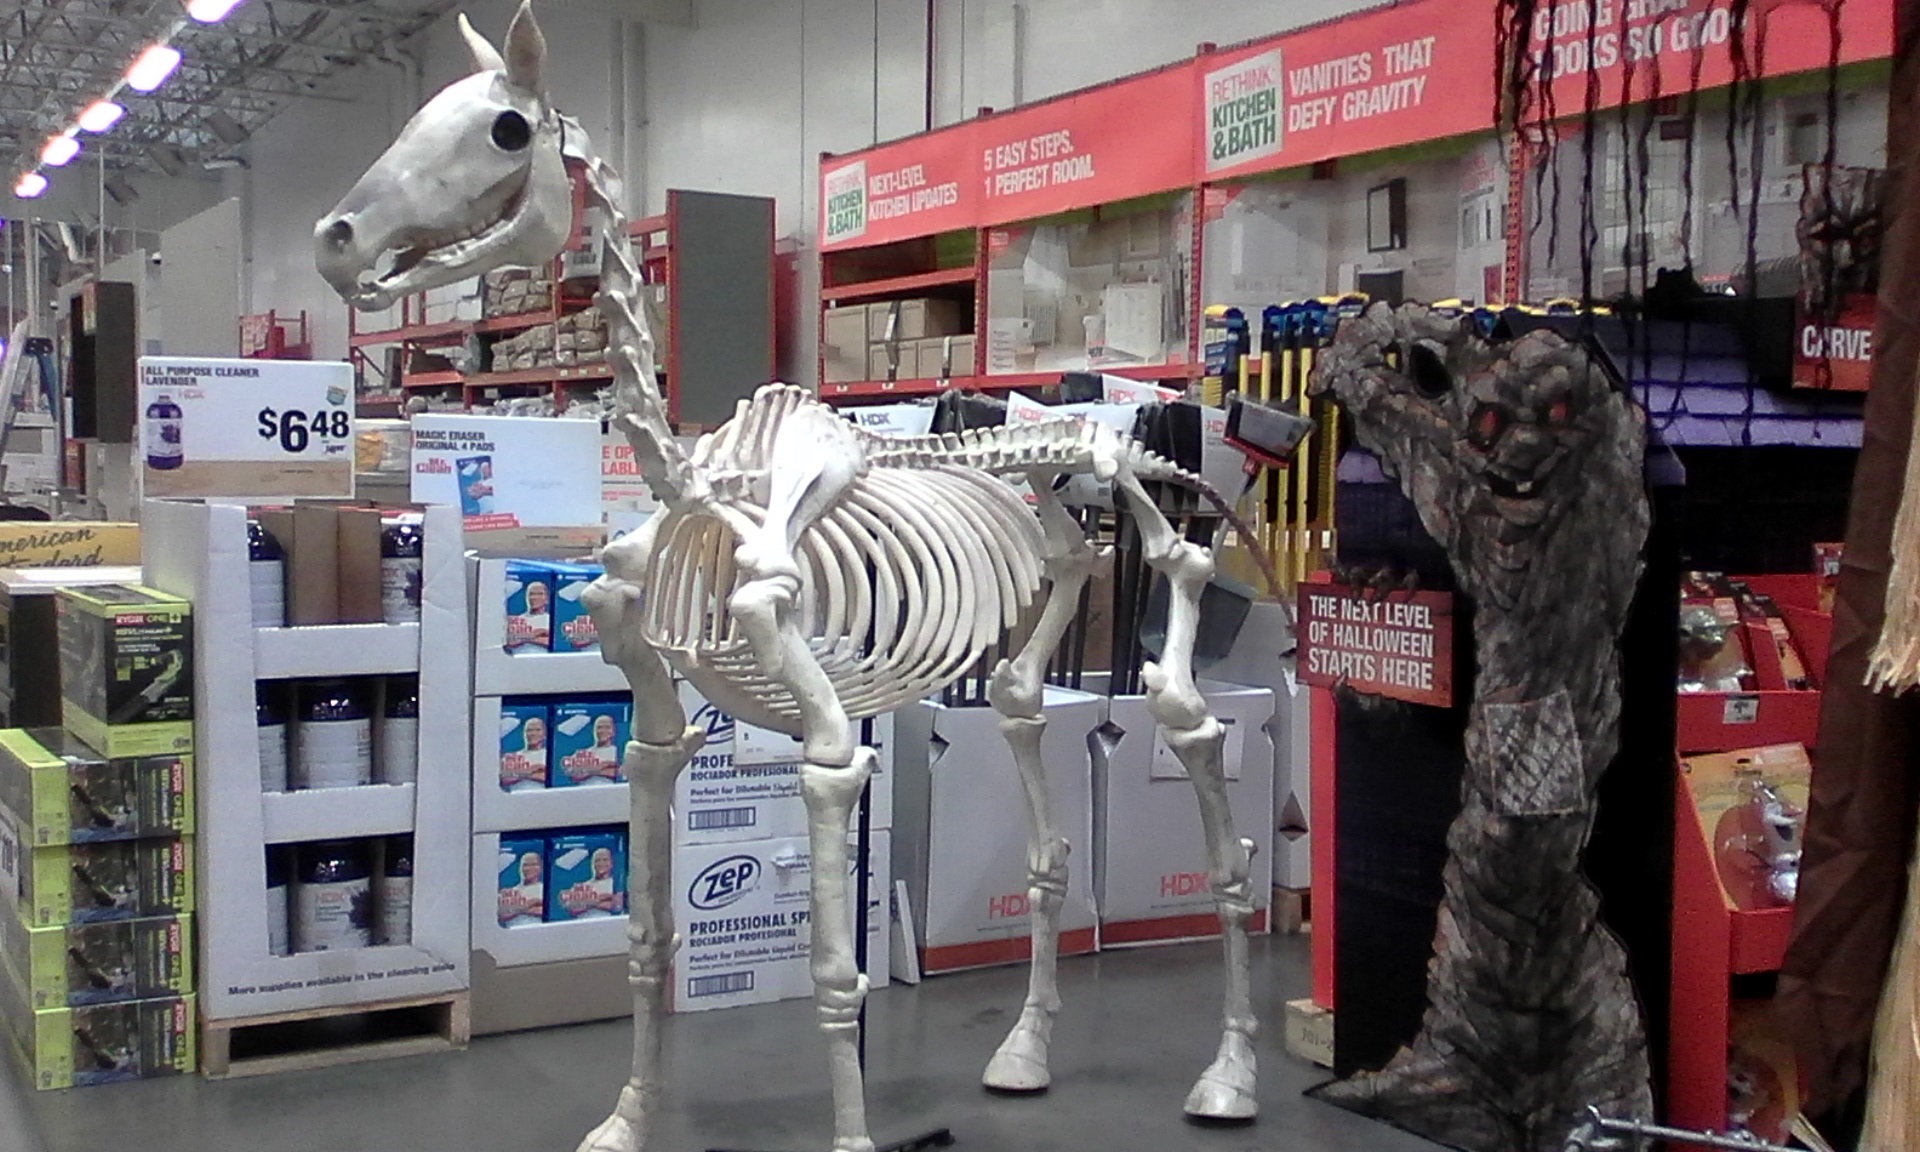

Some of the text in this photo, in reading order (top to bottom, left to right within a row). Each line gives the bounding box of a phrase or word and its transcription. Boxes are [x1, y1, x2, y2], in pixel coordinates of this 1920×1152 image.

[1670, 7, 1747, 52] GOO
[1289, 36, 1435, 97] VANITIES THAT
[1212, 87, 1276, 128] KITCHEN
[1288, 75, 1427, 133] DEFY GRAVITY
[984, 129, 1074, 171] 5 EASY STEPS.
[869, 164, 926, 197] NEXT-LEVEL
[984, 154, 1095, 198] 1 PERFECT ROOM.
[828, 188, 863, 213] KITCHEN
[868, 182, 958, 222] KITCHEN UPDATES
[146, 366, 259, 378] ALL PURPOSE CLEANER
[146, 376, 198, 386] LAVENDER
[860, 412, 891, 426] HDX
[415, 430, 485, 442] MAGIC ERASER
[415, 440, 495, 452] ORIGINAL 4 PADS
[1309, 595, 1434, 629] THE NEXT LEVEL
[1308, 620, 1434, 658] OF HALLOWEEN
[1308, 647, 1434, 691] STARTS HERE
[690, 764, 798, 781] ROCIADOR PROFESIONAL
[690, 786, 719, 797] Perfect
[721, 785, 734, 794] for
[735, 783, 771, 794] Dilutable
[1160, 872, 1211, 898] HDX
[689, 928, 797, 948] ROCIADOR PROFESIONAL
[690, 913, 787, 936] PROFESSIONAL
[689, 952, 718, 963] Perfect
[720, 951, 732, 960] for
[733, 947, 770, 959] Dilutable
[228, 962, 455, 995] More supplies available in the cleaning aisle
